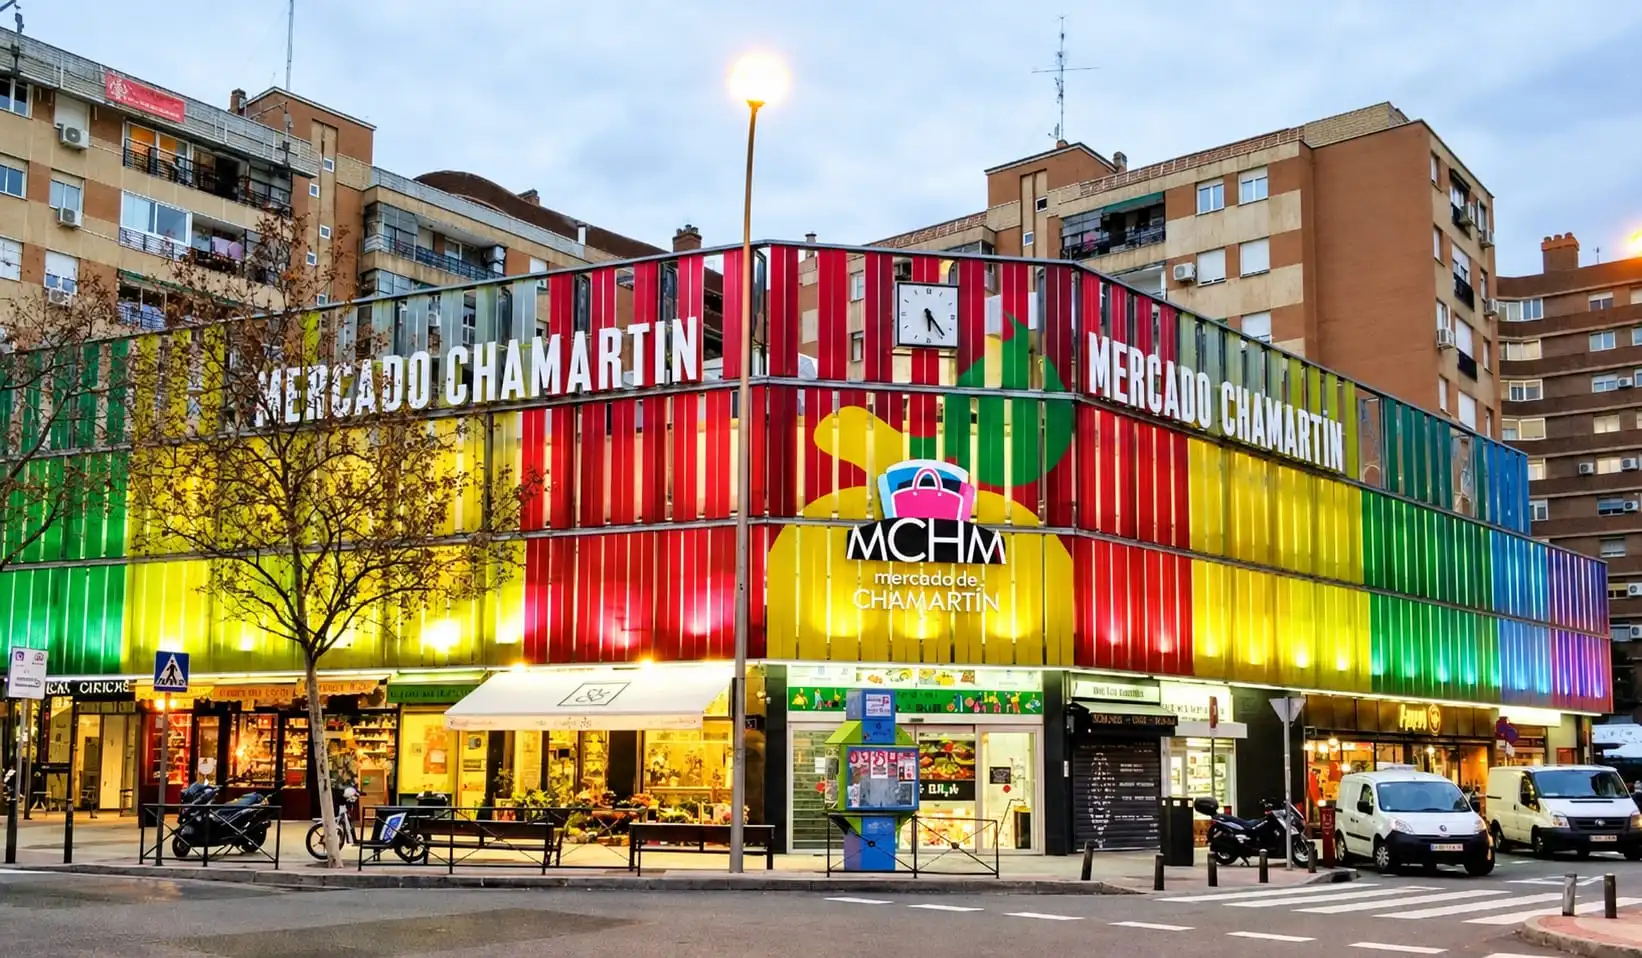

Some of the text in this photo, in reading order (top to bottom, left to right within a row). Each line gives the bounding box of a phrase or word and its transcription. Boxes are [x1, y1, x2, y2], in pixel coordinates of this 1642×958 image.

[253, 351, 430, 427] MERCADO
[1088, 331, 1212, 429] MERCADO
[847, 517, 1007, 564] MCHM
[853, 583, 1000, 612] CHAMARTÍN
[875, 569, 978, 587] mercado de
